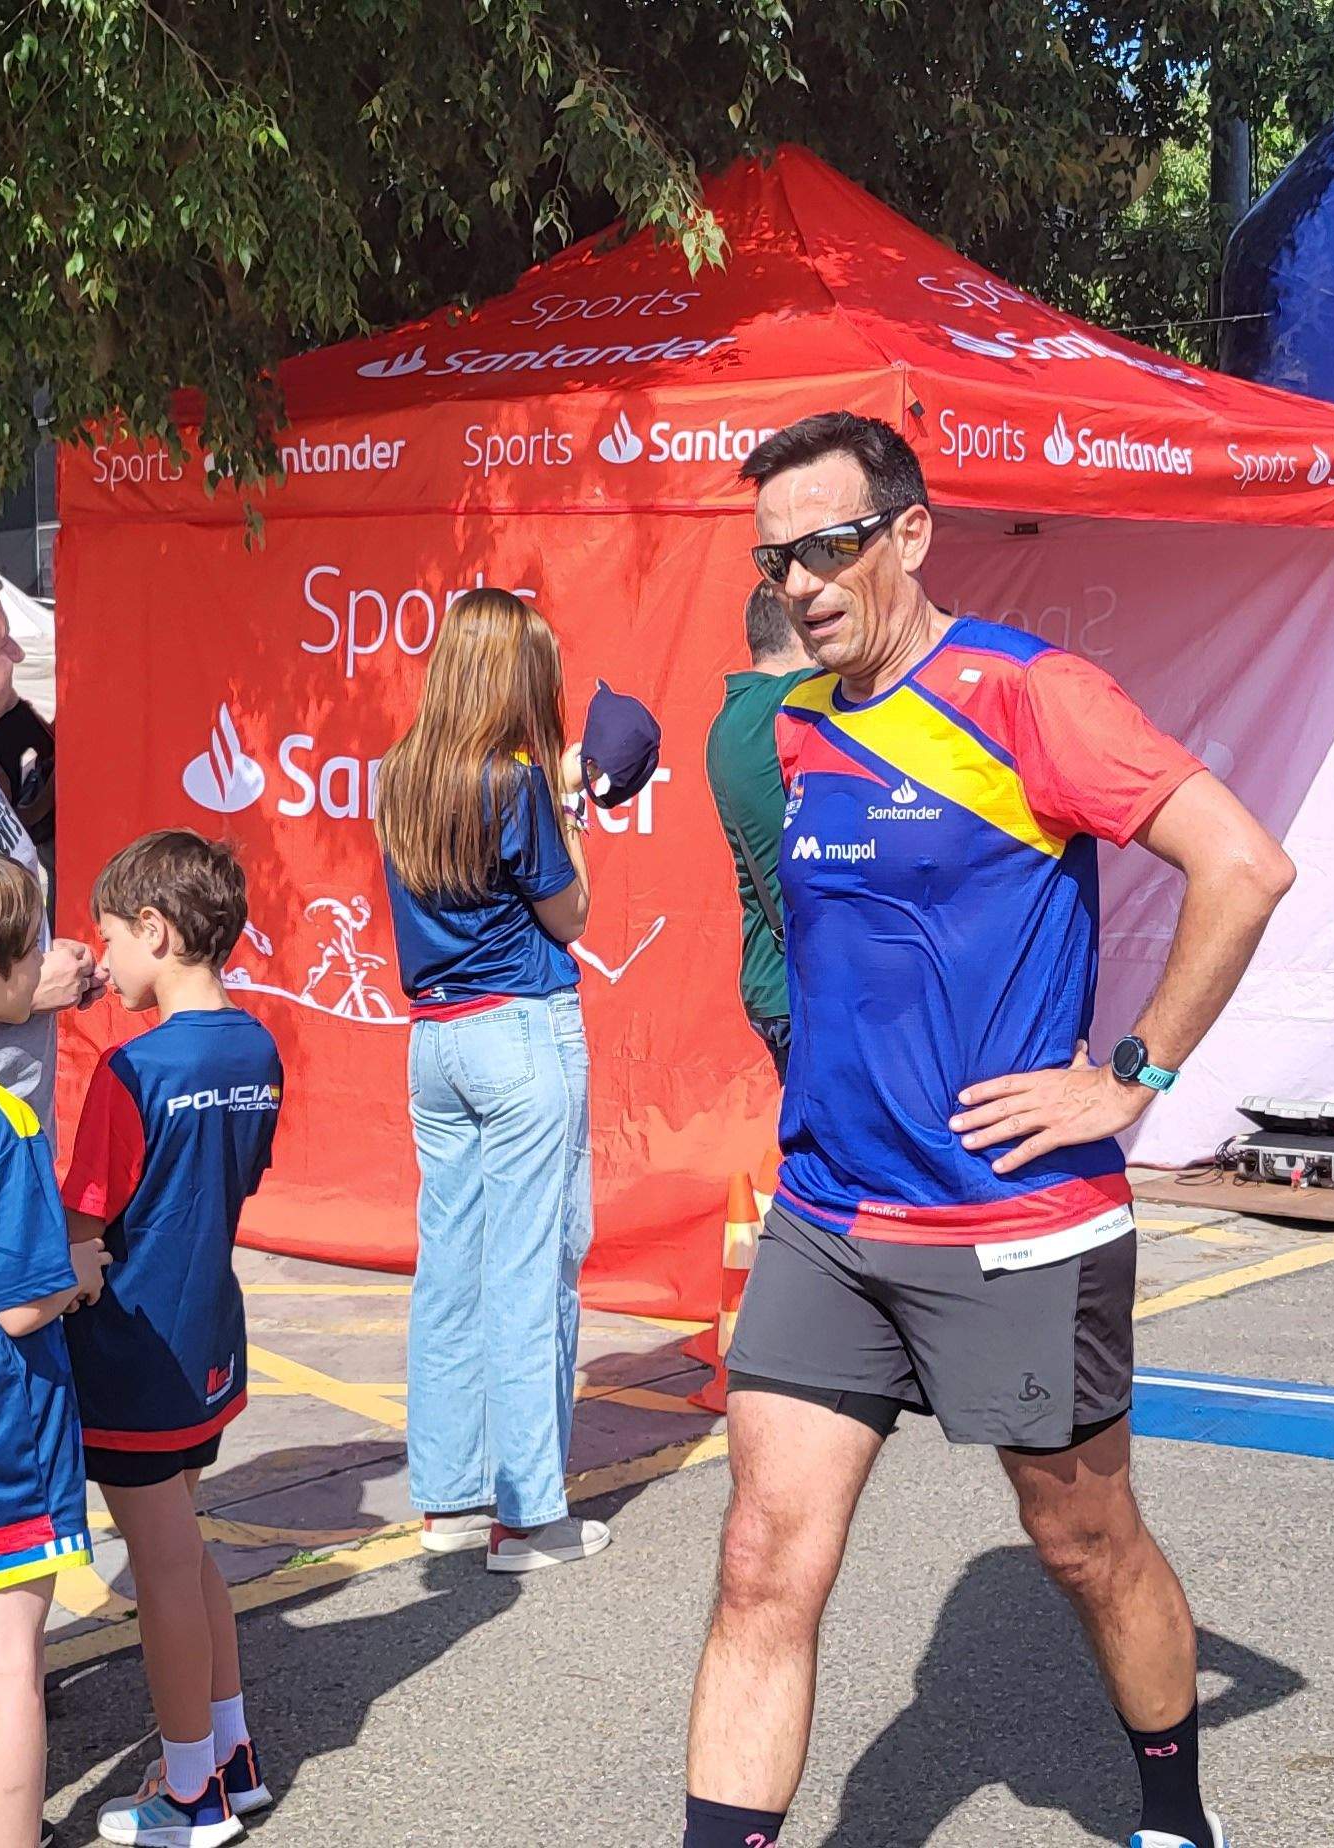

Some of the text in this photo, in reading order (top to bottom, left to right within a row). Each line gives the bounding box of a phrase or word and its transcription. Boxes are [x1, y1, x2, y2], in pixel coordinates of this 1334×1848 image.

[510, 287, 701, 330] Sports
[424, 335, 739, 377] Santander
[281, 433, 407, 474] ntander
[462, 421, 775, 478] Sports Santa
[938, 407, 1194, 476] Sports Santander
[1226, 442, 1299, 491] Sports
[300, 564, 537, 679] Spo
[866, 805, 943, 821] Santander
[825, 837, 876, 864] mupol
[228, 1102, 279, 1113] NACION
